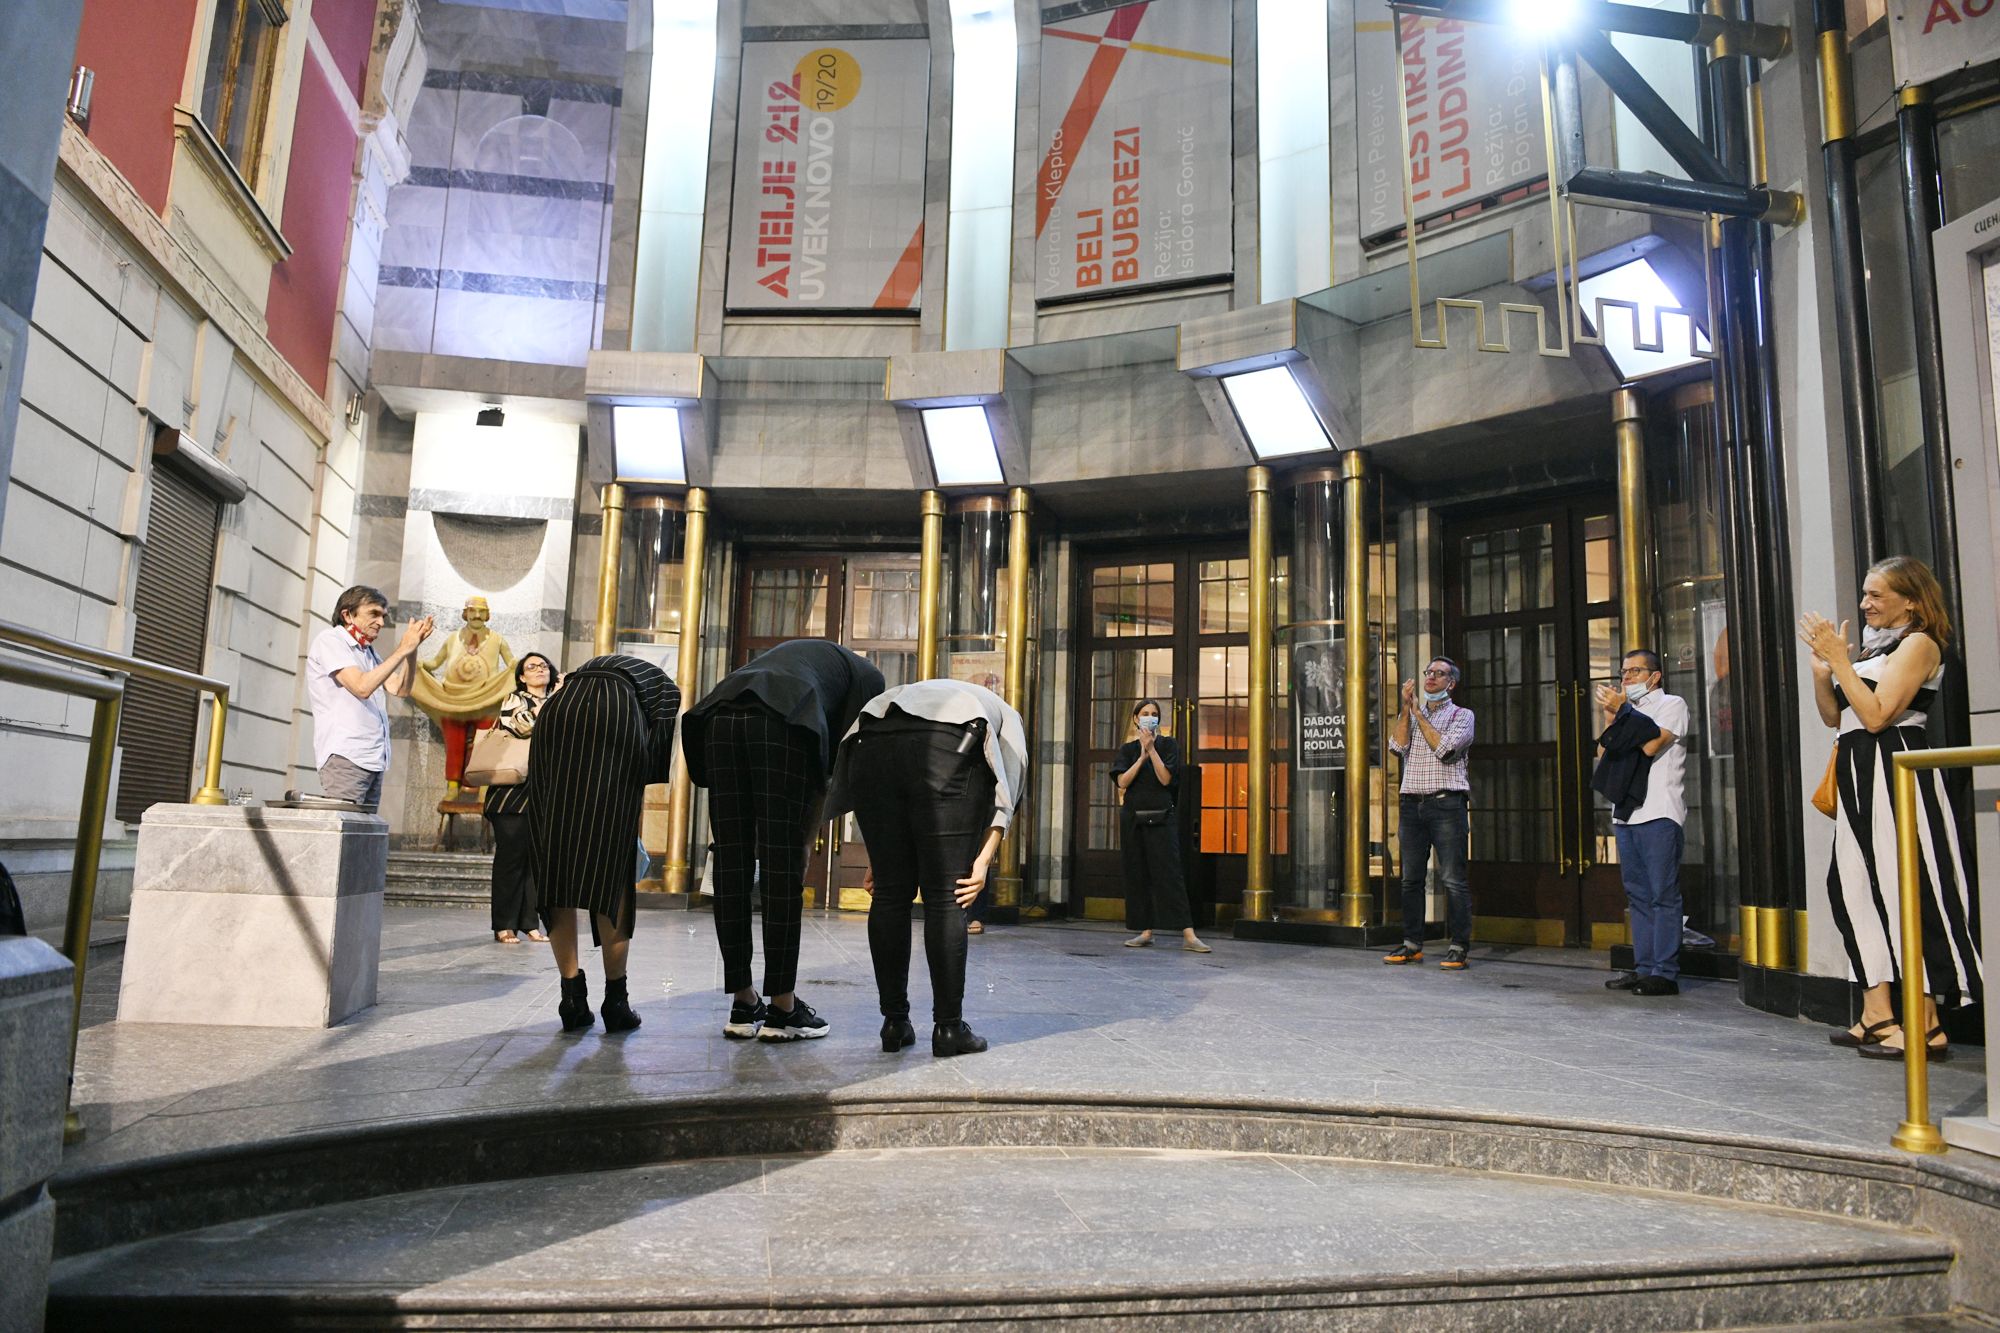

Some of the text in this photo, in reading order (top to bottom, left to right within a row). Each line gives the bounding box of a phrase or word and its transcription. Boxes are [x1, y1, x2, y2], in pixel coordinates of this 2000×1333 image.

[816, 54, 837, 110] 19/20
[1367, 84, 1391, 229] Maja Pelević
[1486, 103, 1507, 185] Režija:
[1510, 102, 1534, 177] Bojan
[757, 161, 796, 299] ATELJE
[798, 117, 834, 301] UVEK NOVO
[1044, 128, 1066, 293] Vedrana Klepica
[1112, 127, 1140, 283] BUBREZI
[1177, 203, 1194, 275] Isidora
[1974, 212, 2000, 234] СЦЕН
[1076, 208, 1103, 288] BELI
[1154, 209, 1176, 279] Režija:
[1303, 728, 1342, 739] MAJKA
[1303, 740, 1346, 751] RODILA
